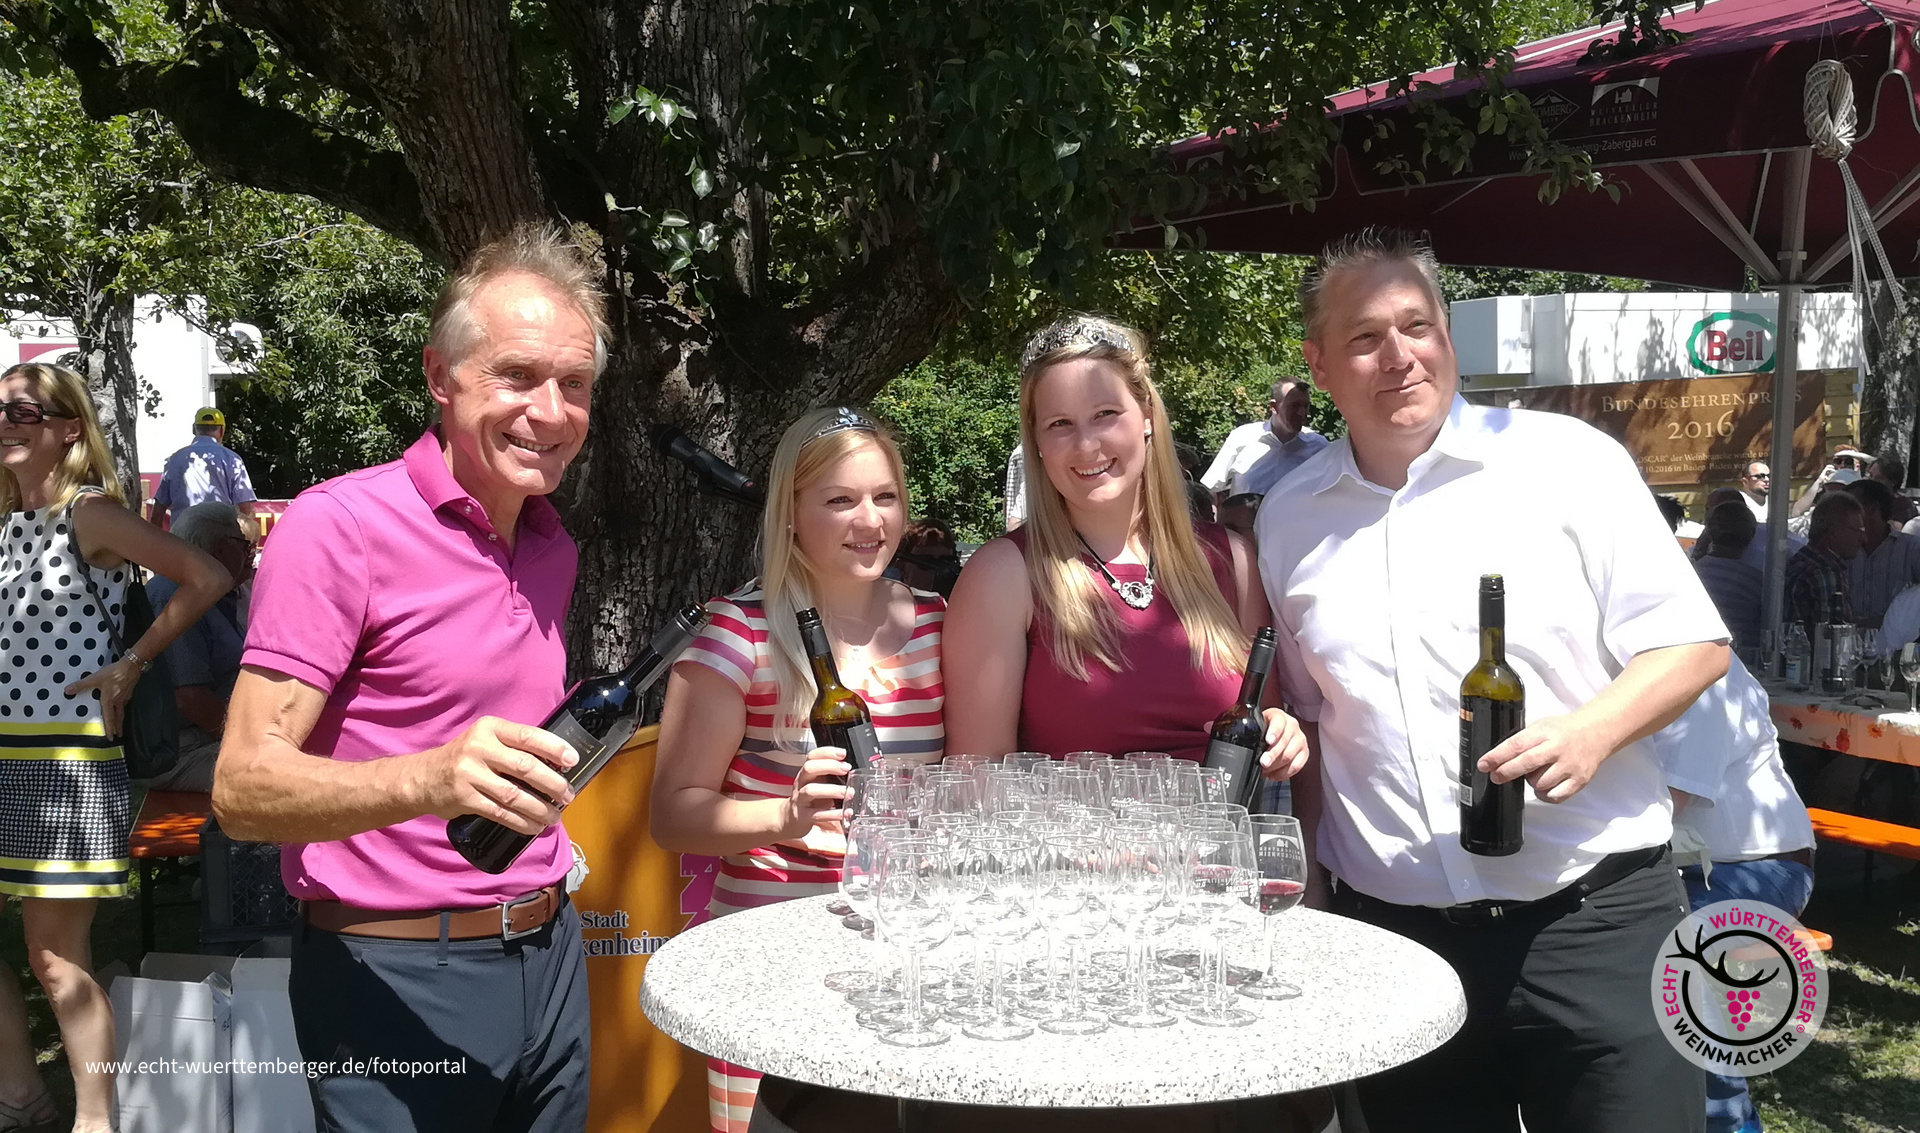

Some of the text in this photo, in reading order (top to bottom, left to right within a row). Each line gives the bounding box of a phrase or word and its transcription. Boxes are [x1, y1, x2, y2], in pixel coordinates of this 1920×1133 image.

[1590, 112, 1657, 126] BRACKENHEIM
[1706, 330, 1764, 361] Beil
[1667, 410, 1734, 440] 2016
[1670, 454, 1683, 463] der
[580, 910, 630, 929] Stadt
[582, 930, 671, 957] kenheim
